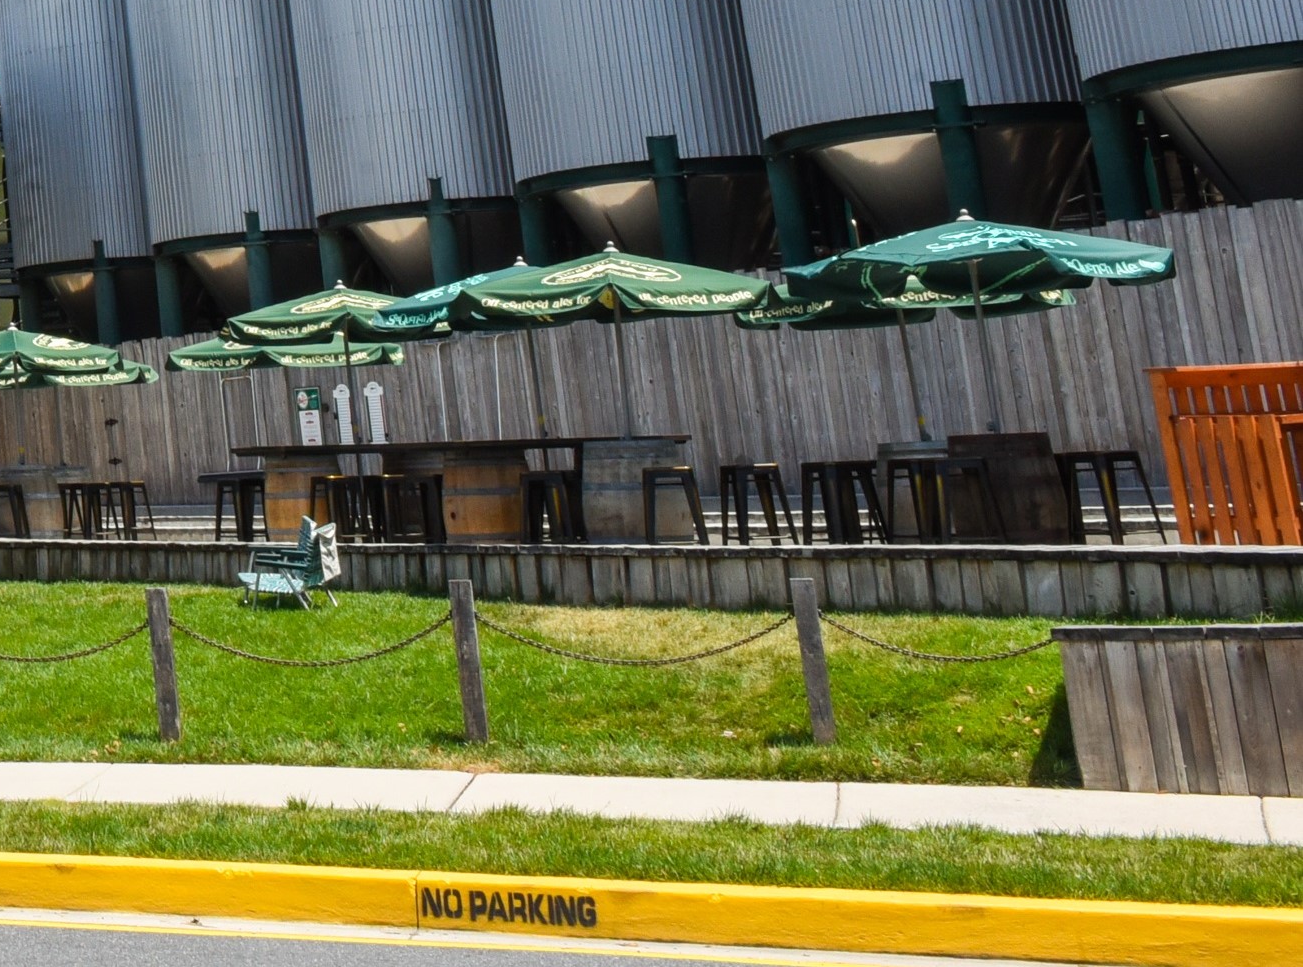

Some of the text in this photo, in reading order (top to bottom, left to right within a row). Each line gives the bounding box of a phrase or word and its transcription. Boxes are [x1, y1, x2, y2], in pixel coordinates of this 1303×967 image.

[1115, 261, 1141, 275] Ale
[552, 297, 573, 309] ales
[576, 294, 592, 305] for
[281, 354, 334, 364] off-centered
[421, 887, 597, 929] NO PARKING
